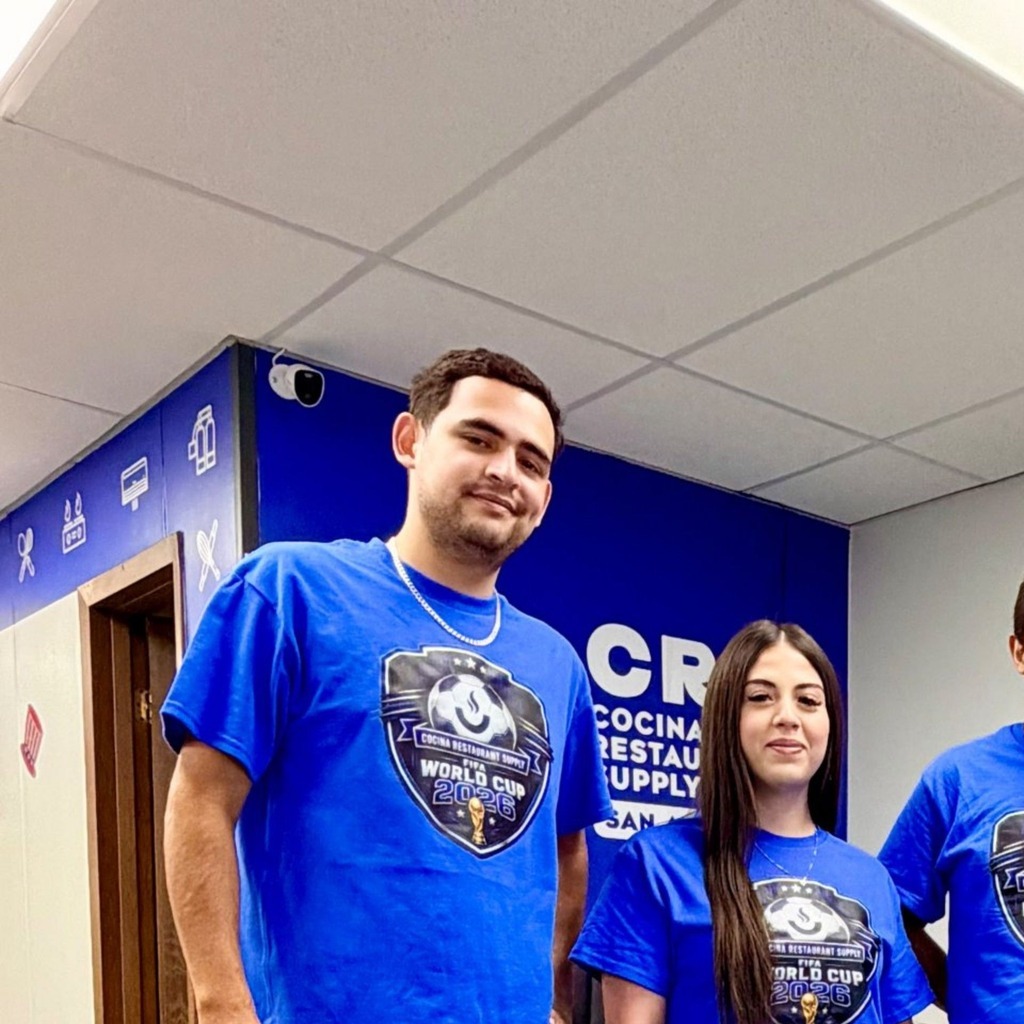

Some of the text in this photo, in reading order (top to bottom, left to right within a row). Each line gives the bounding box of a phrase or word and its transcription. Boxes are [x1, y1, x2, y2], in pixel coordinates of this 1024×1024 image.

[420, 759, 525, 800] WORLD CUP
[463, 759, 485, 772] FIFA
[605, 765, 700, 799] UPPLY
[433, 779, 515, 821] 2026
[772, 967, 863, 986] ORLD CUP
[771, 982, 851, 1007] 2026
